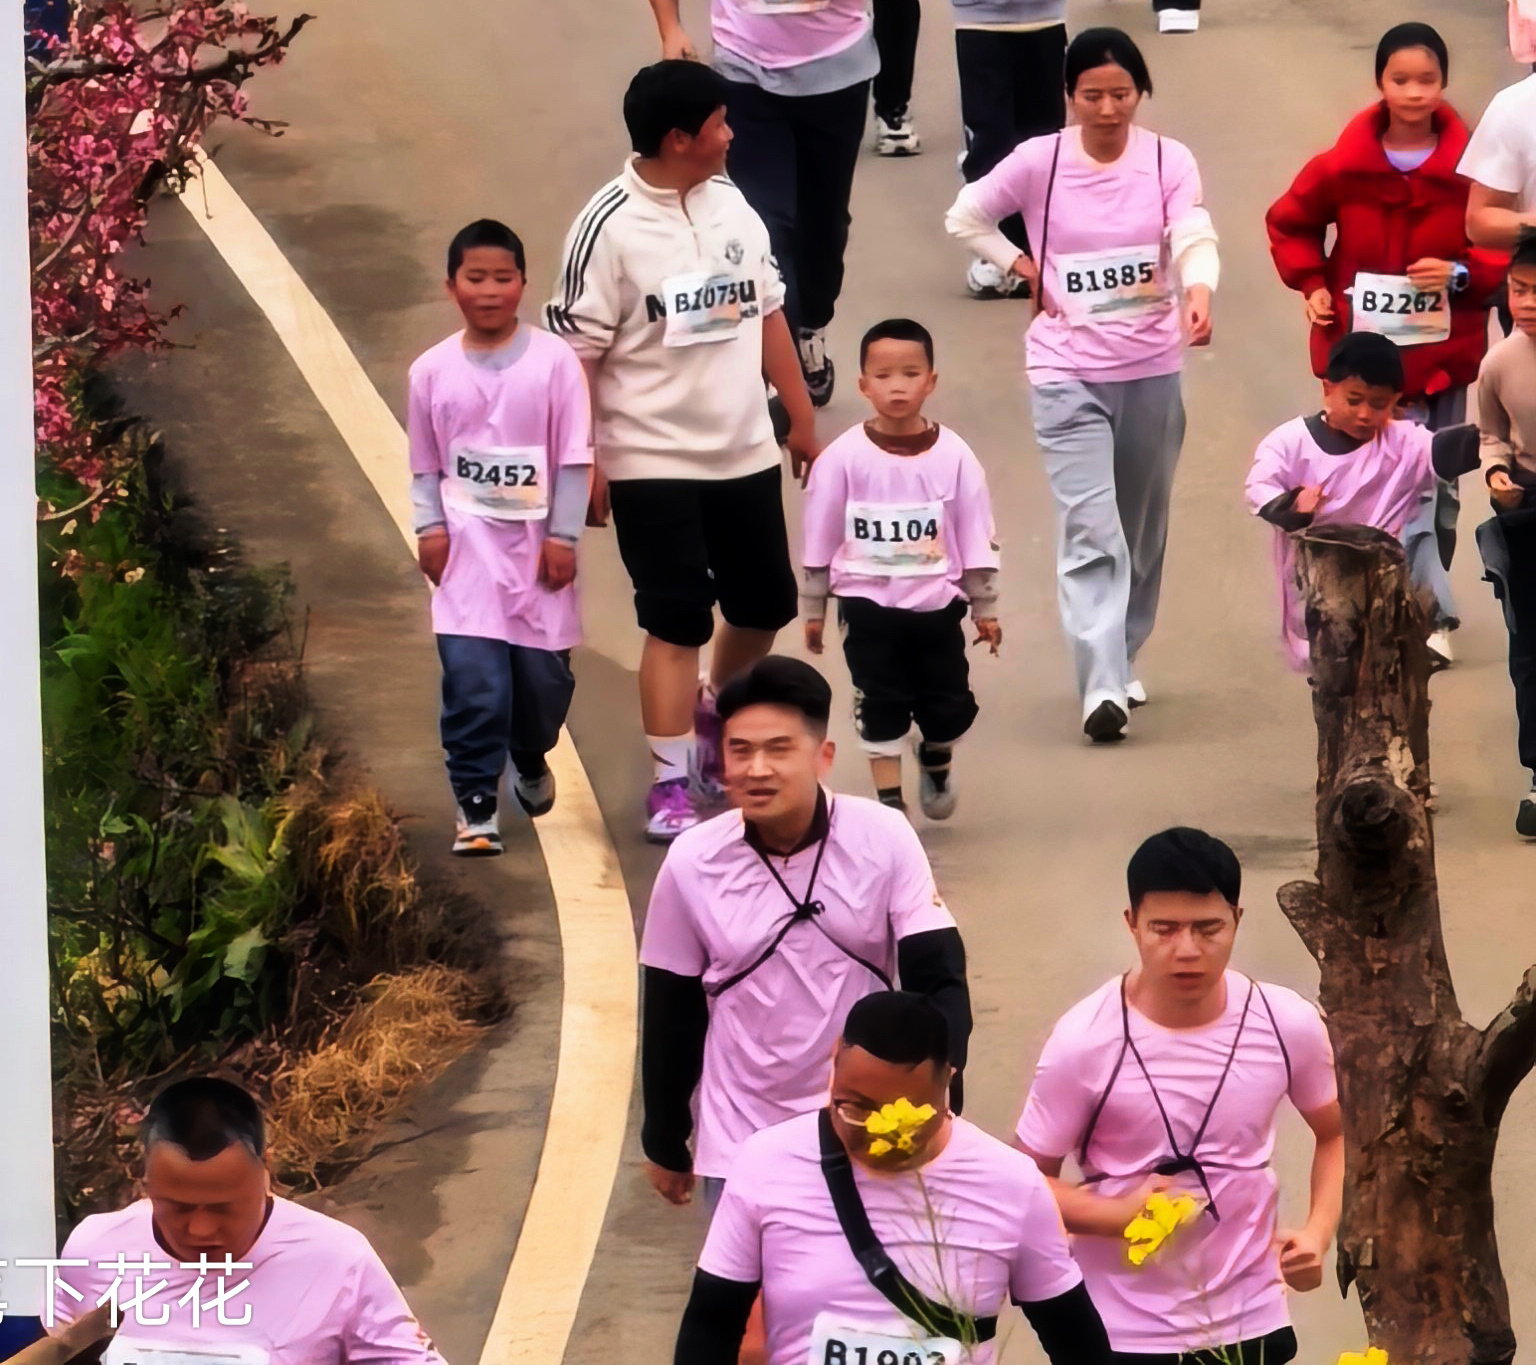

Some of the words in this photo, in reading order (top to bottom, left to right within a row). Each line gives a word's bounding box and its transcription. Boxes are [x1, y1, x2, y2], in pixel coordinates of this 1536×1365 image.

[1066, 262, 1155, 293] B1885
[1362, 290, 1443, 315] B2262
[457, 455, 538, 487] B2452
[854, 517, 938, 542] B1104
